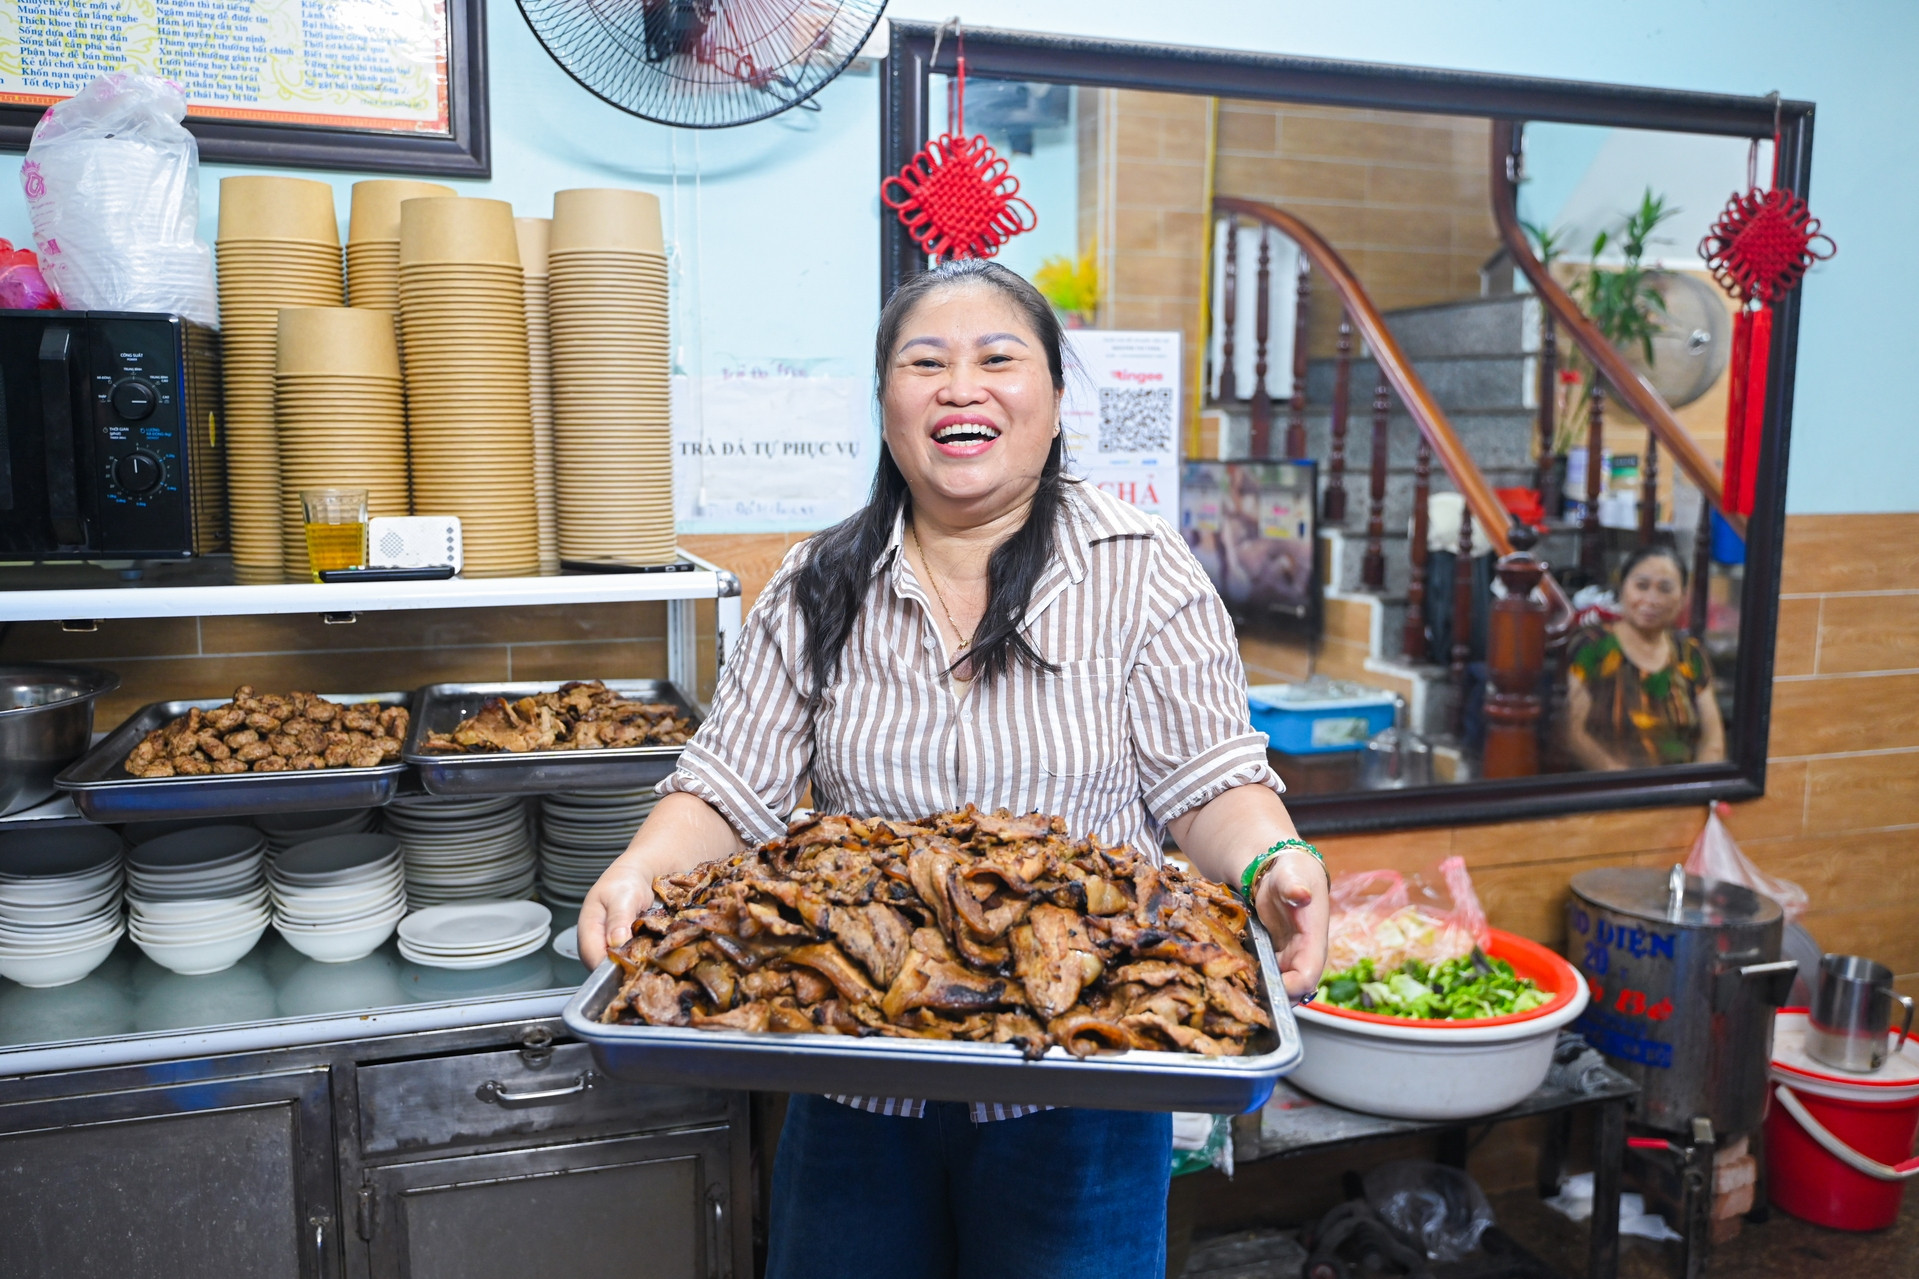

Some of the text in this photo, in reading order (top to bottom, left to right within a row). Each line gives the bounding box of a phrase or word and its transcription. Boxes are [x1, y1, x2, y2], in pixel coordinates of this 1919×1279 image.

[18, 5, 46, 14] Muốn
[49, 7, 70, 16] hiểu
[116, 14, 138, 23] nghe
[18, 16, 46, 25] Thích
[48, 18, 72, 27] khoe
[74, 20, 88, 28] thì
[90, 21, 102, 30] trí
[196, 20, 212, 30] hay
[18, 26, 43, 36] Sống
[46, 28, 64, 38] dựa
[90, 33, 108, 41] ngu
[214, 32, 229, 41] hay
[20, 36, 44, 46] Sống
[46, 38, 62, 47] bất
[85, 42, 102, 50] phá
[105, 43, 122, 52] sản
[20, 46, 46, 57] Phận
[48, 48, 65, 58] bạc
[82, 52, 100, 60] bán
[103, 54, 127, 62] mình
[158, 48, 172, 56] Xu
[21, 57, 35, 66] Kẻ
[54, 60, 74, 69] chơi
[77, 60, 94, 70] xấu
[97, 64, 115, 72] bạn
[212, 62, 228, 72] hay
[22, 68, 48, 77] Khốn
[72, 72, 96, 82] quên
[203, 71, 219, 81] hay
[22, 77, 39, 86] Tốt
[42, 80, 60, 90] đẹp
[64, 81, 80, 91] hãy
[216, 82, 232, 92] hay
[214, 92, 230, 102] hay
[678, 438, 716, 456] TRÀ
[782, 441, 831, 459] PHỤC
[836, 441, 860, 459] VỤ
